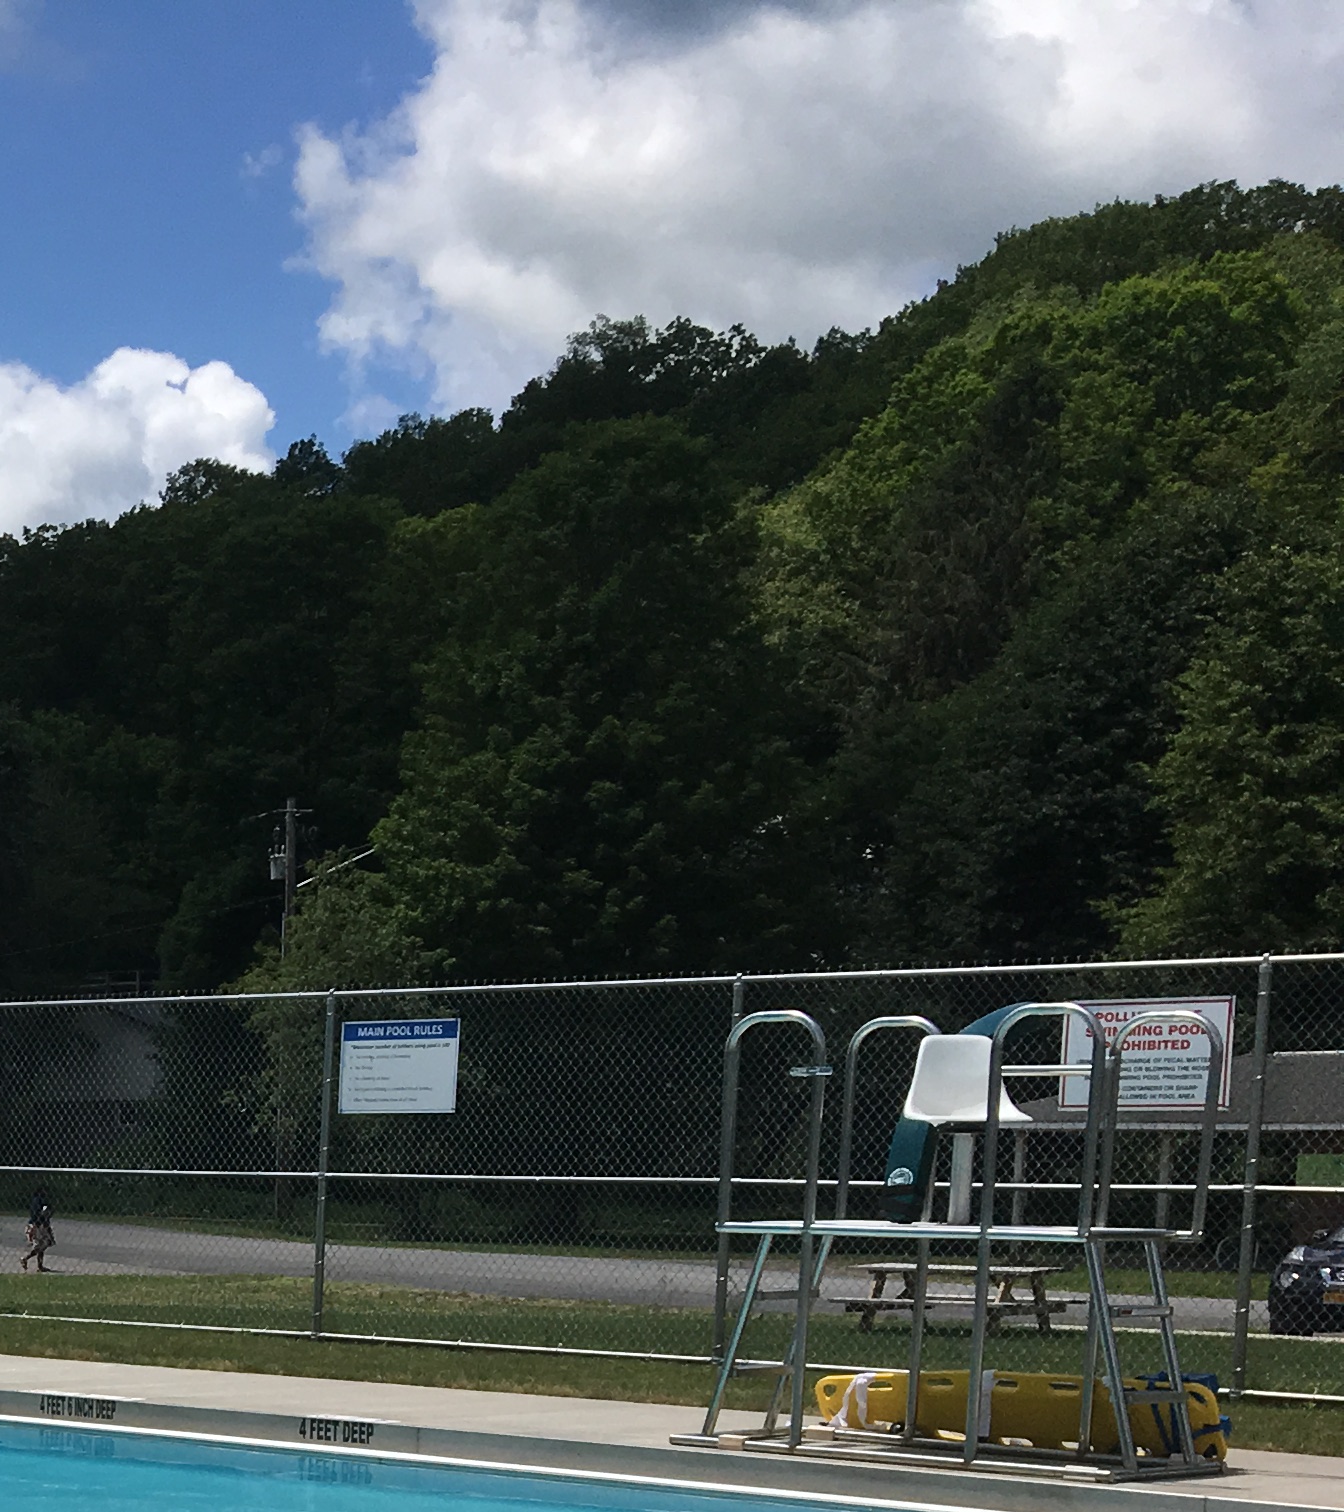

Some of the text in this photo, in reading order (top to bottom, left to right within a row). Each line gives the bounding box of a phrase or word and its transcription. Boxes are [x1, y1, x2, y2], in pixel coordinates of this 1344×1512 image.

[357, 1024, 443, 1037] MAIN POOL RULES
[1104, 1039, 1191, 1051] OHIBITED
[40, 1395, 117, 1419] 4 FEET 6 INCH DEEP
[299, 1418, 374, 1444] 4 FEET DEEP
